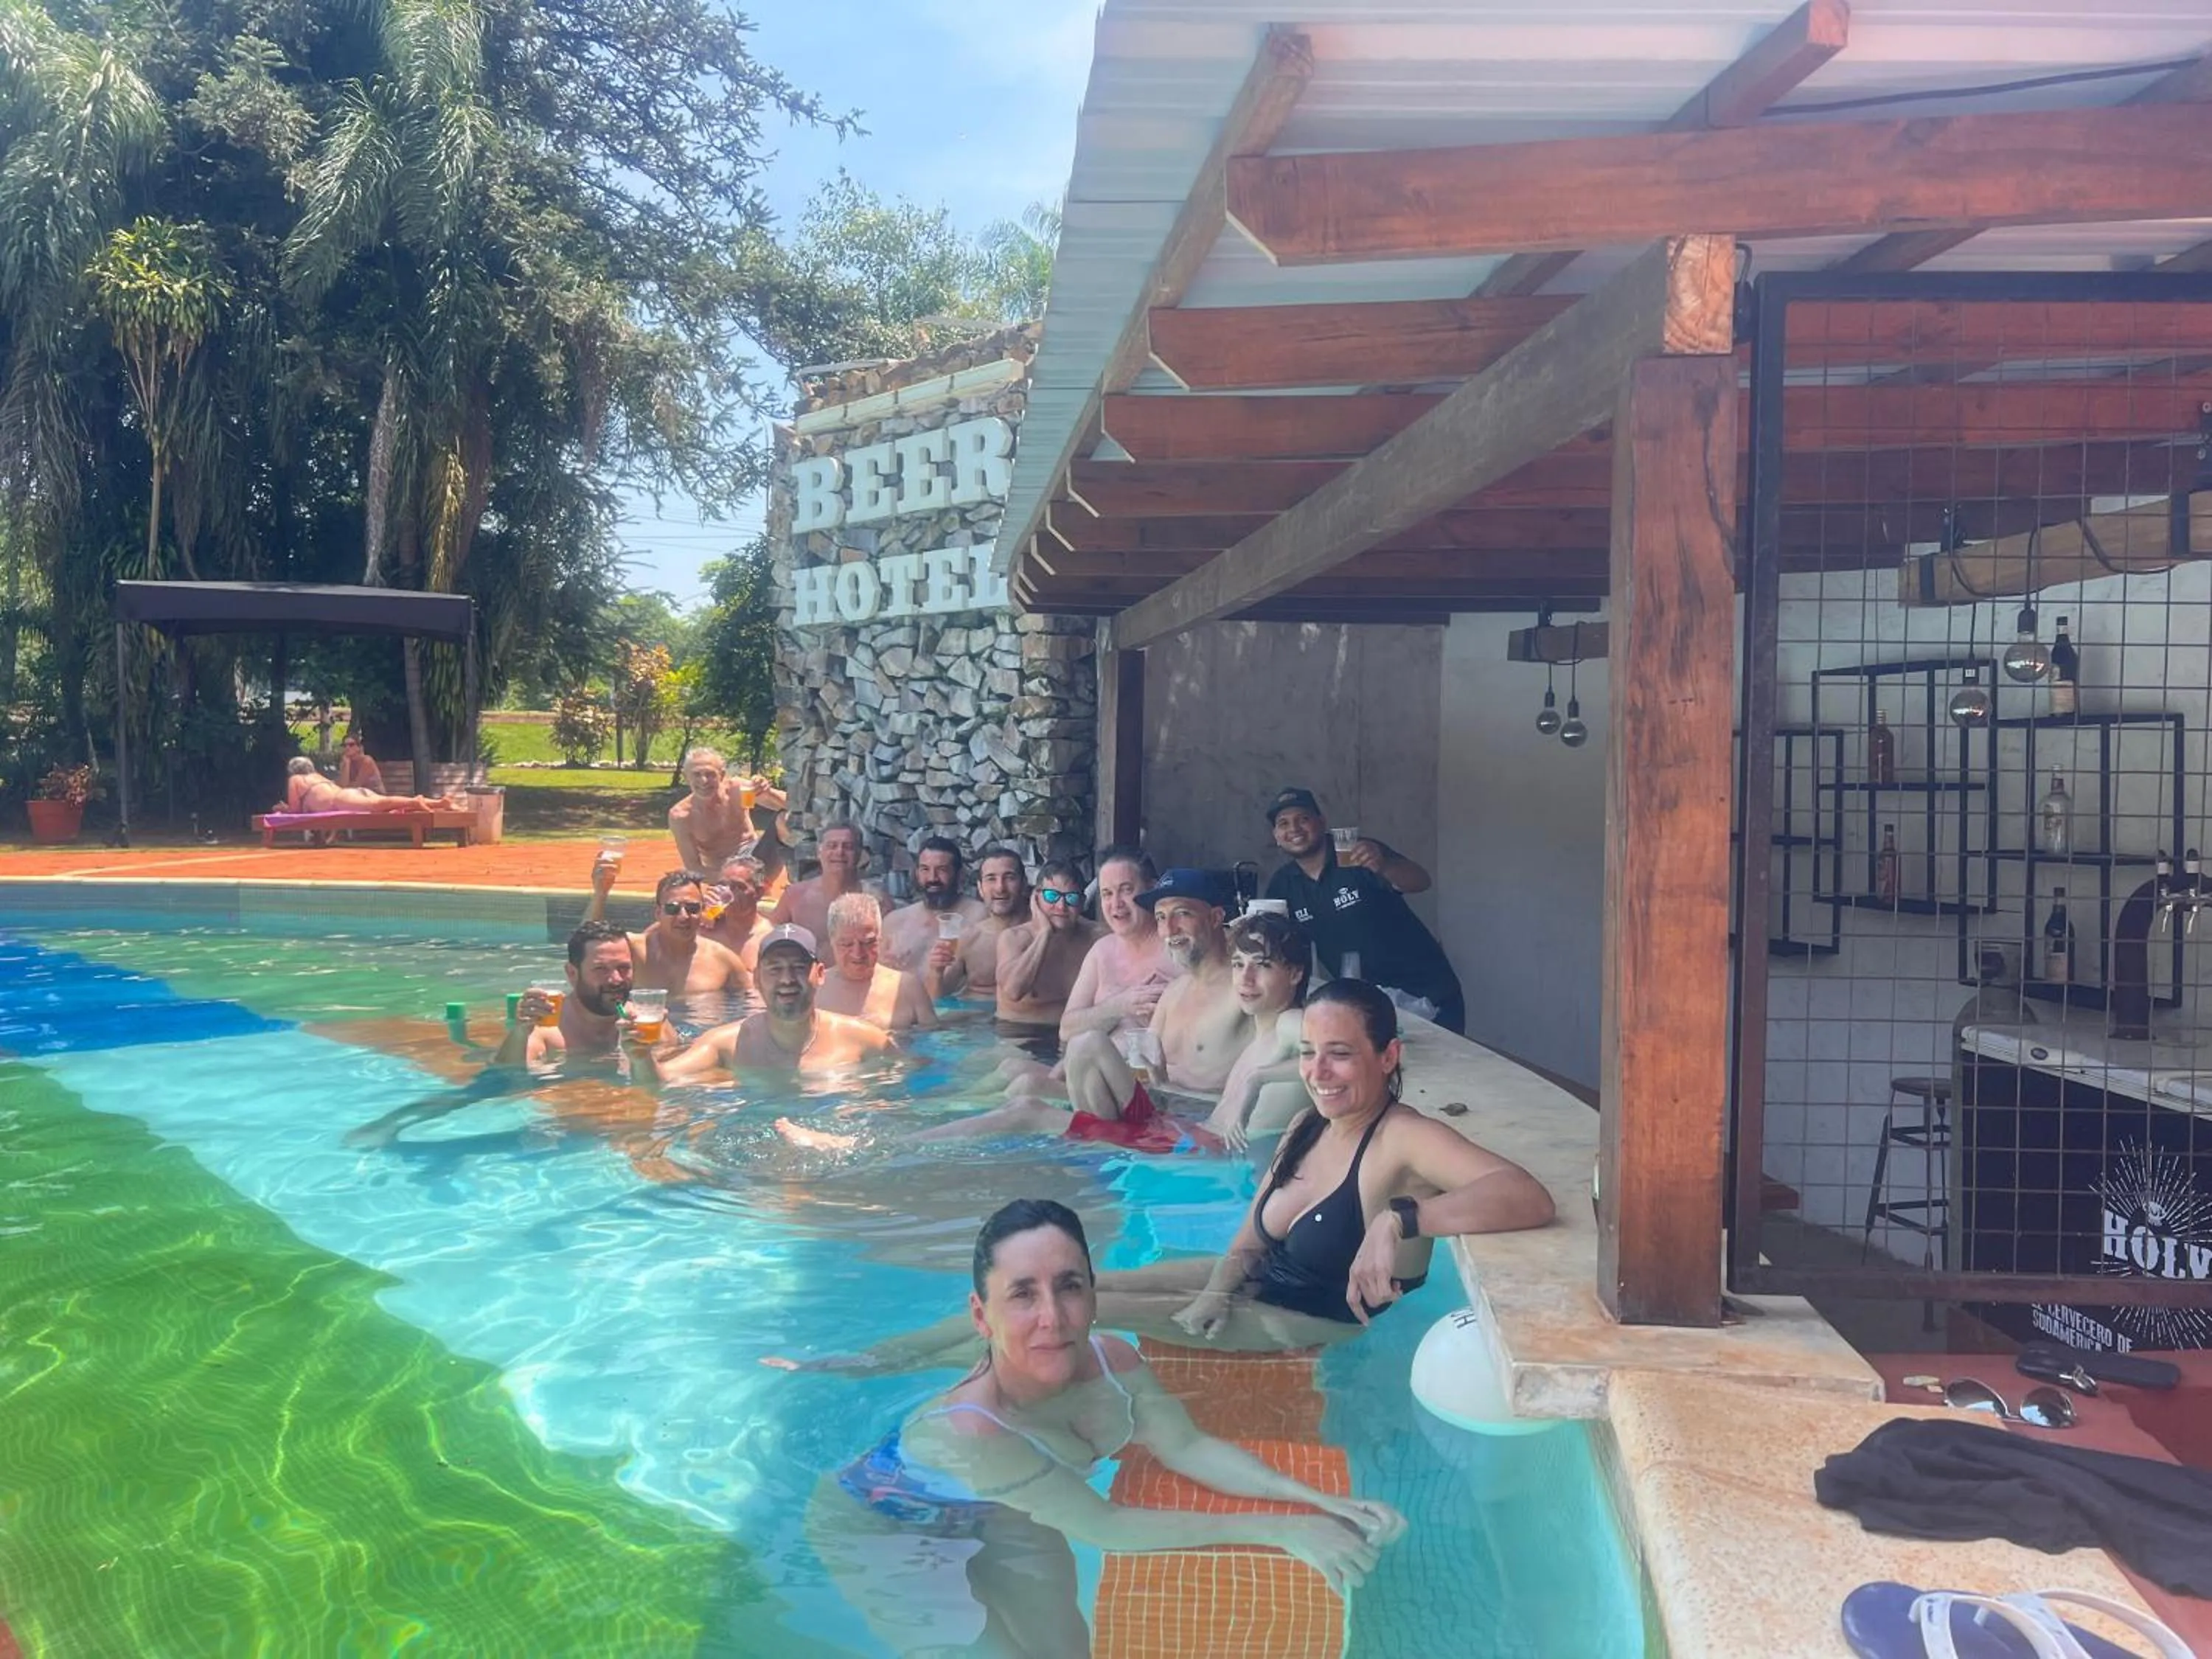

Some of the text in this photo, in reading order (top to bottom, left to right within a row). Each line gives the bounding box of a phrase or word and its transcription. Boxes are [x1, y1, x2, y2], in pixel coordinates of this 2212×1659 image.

[792, 417, 1013, 535] BEER
[792, 540, 1009, 626] HOTEL
[1333, 889, 1359, 907] HOLY
[2048, 1304, 2133, 1353] CERVECERO DE
